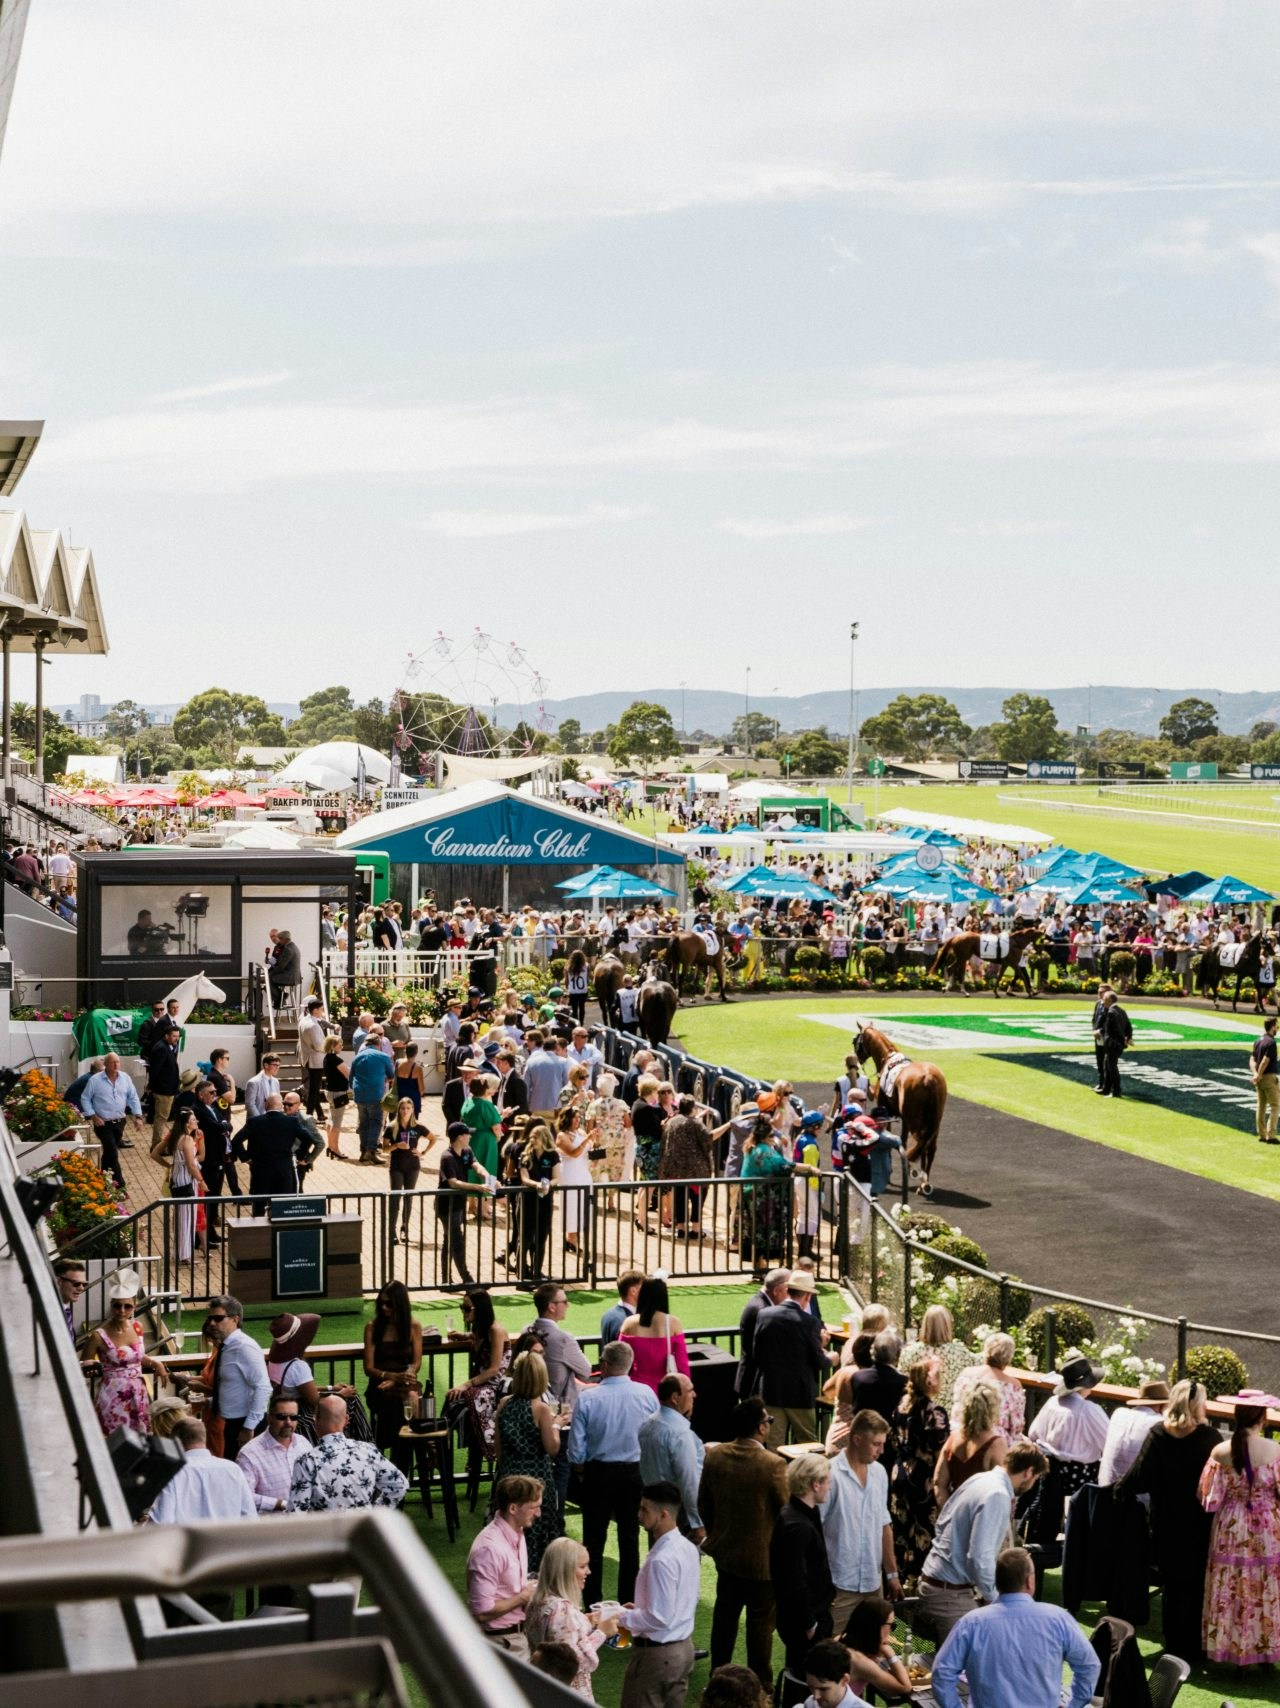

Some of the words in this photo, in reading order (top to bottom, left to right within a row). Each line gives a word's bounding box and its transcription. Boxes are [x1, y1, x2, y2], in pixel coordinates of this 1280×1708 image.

[1042, 765, 1075, 775] FURPHY
[384, 791, 419, 800] SCHNITZEL
[273, 798, 299, 807] BAKED
[301, 799, 340, 808] POTATOES
[425, 827, 533, 857] Canadian
[534, 828, 592, 858] Club
[983, 940, 990, 952] 7
[1264, 968, 1271, 980] 6
[570, 976, 585, 990] 10
[109, 1020, 129, 1029] TAB
